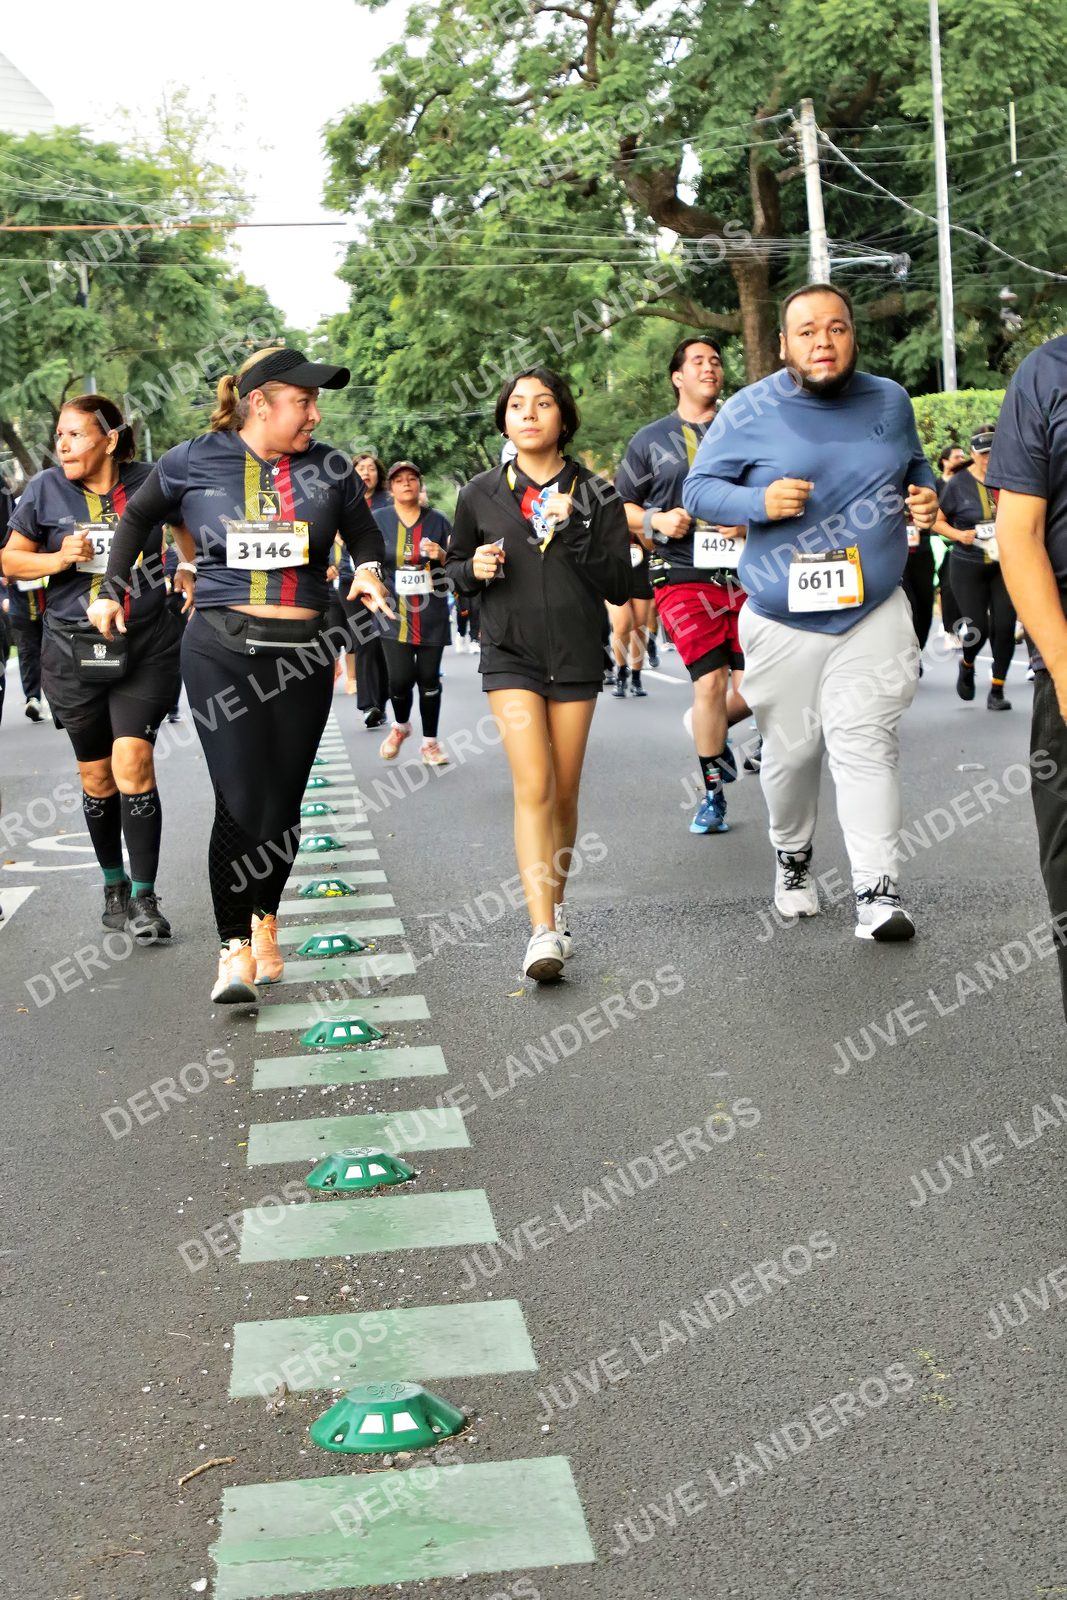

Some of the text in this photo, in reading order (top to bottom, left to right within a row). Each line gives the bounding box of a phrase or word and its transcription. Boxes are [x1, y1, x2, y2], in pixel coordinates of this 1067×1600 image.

[238, 541, 291, 560] 3146
[702, 538, 736, 552] 4492
[401, 575, 425, 586] 4201
[798, 569, 845, 590] 6611
